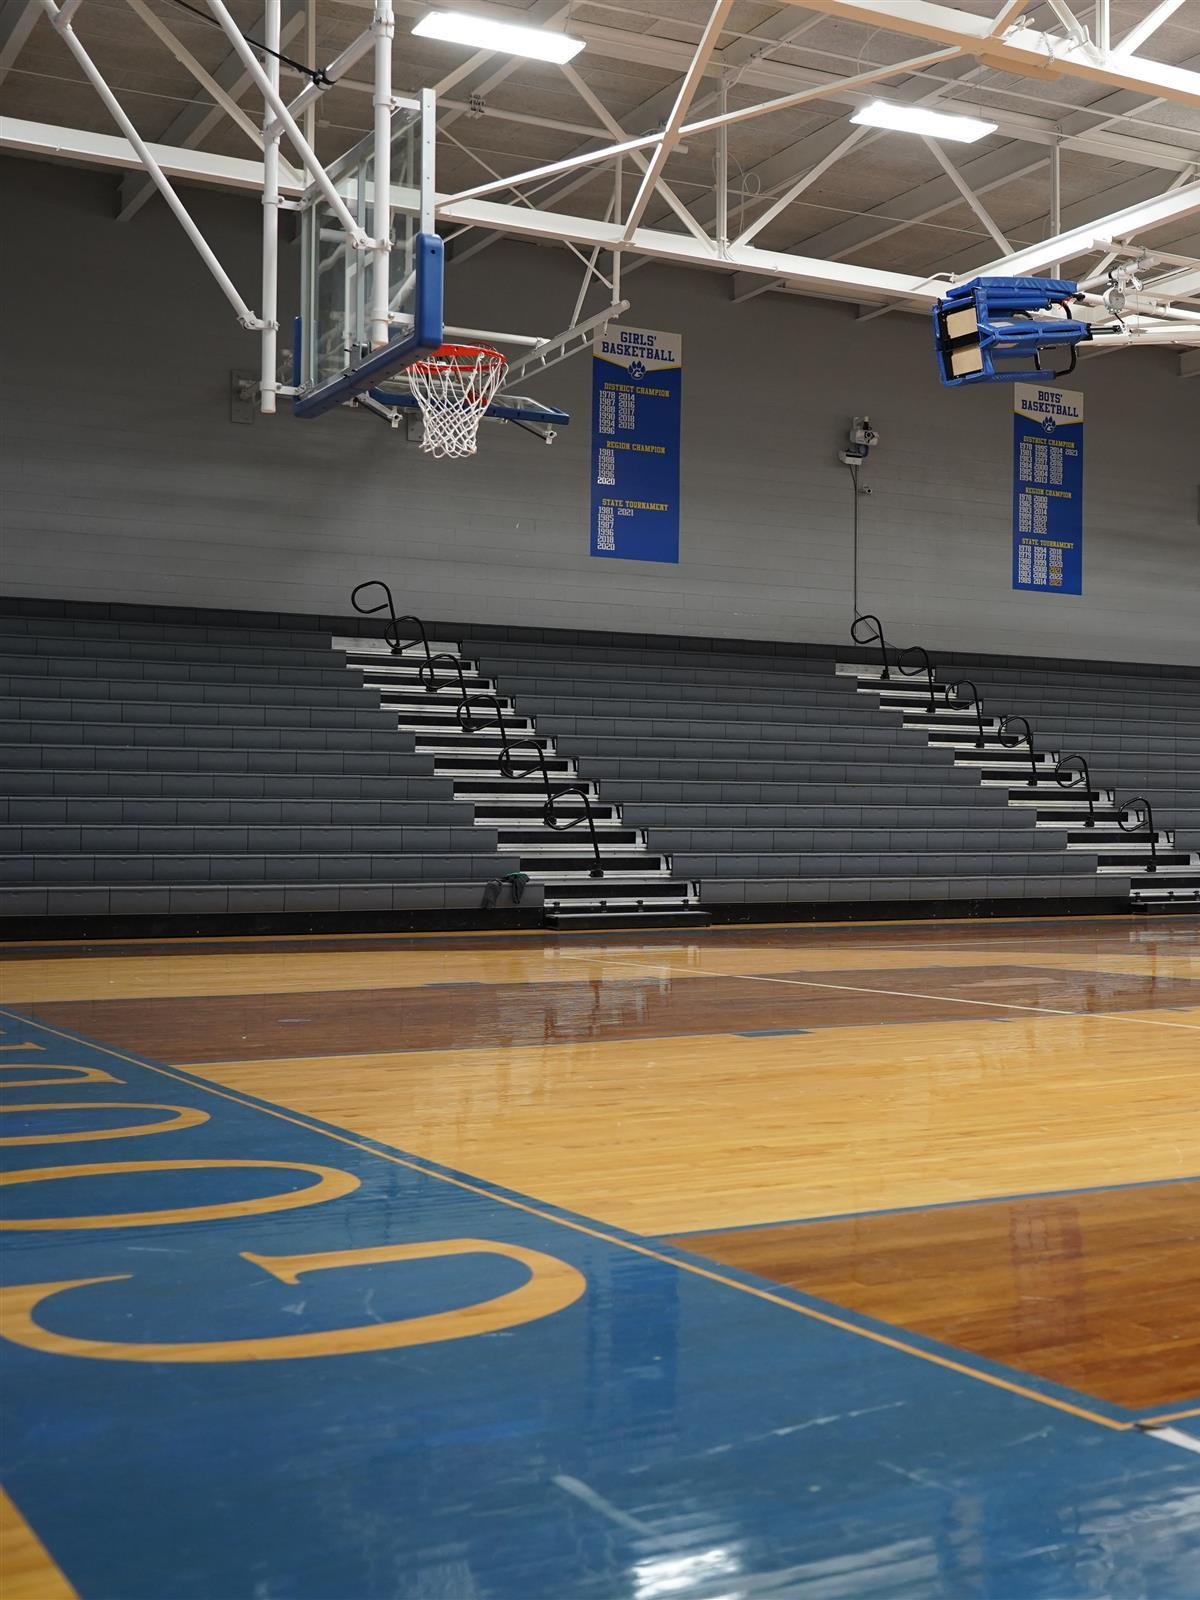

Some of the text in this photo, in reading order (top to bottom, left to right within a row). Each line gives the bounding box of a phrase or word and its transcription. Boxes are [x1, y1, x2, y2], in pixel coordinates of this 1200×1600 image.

[620, 331, 656, 346] GIRLS'
[602, 341, 675, 362] BASKETBALL
[604, 382, 670, 397] DISTRICT CHAMPION
[1038, 391, 1063, 403] BOYS'
[1021, 399, 1079, 418] BASKETBALL
[607, 441, 666, 454] REGION CHAMPION
[1023, 436, 1075, 448] DISTRICT CHAMPION
[597, 476, 615, 486] 2020
[1026, 487, 1072, 499] REGION CHAMPION
[602, 498, 669, 511] STATE TOURNAMENT
[617, 508, 634, 516] 2021
[1040, 540, 1074, 549] TOURNAMENT
